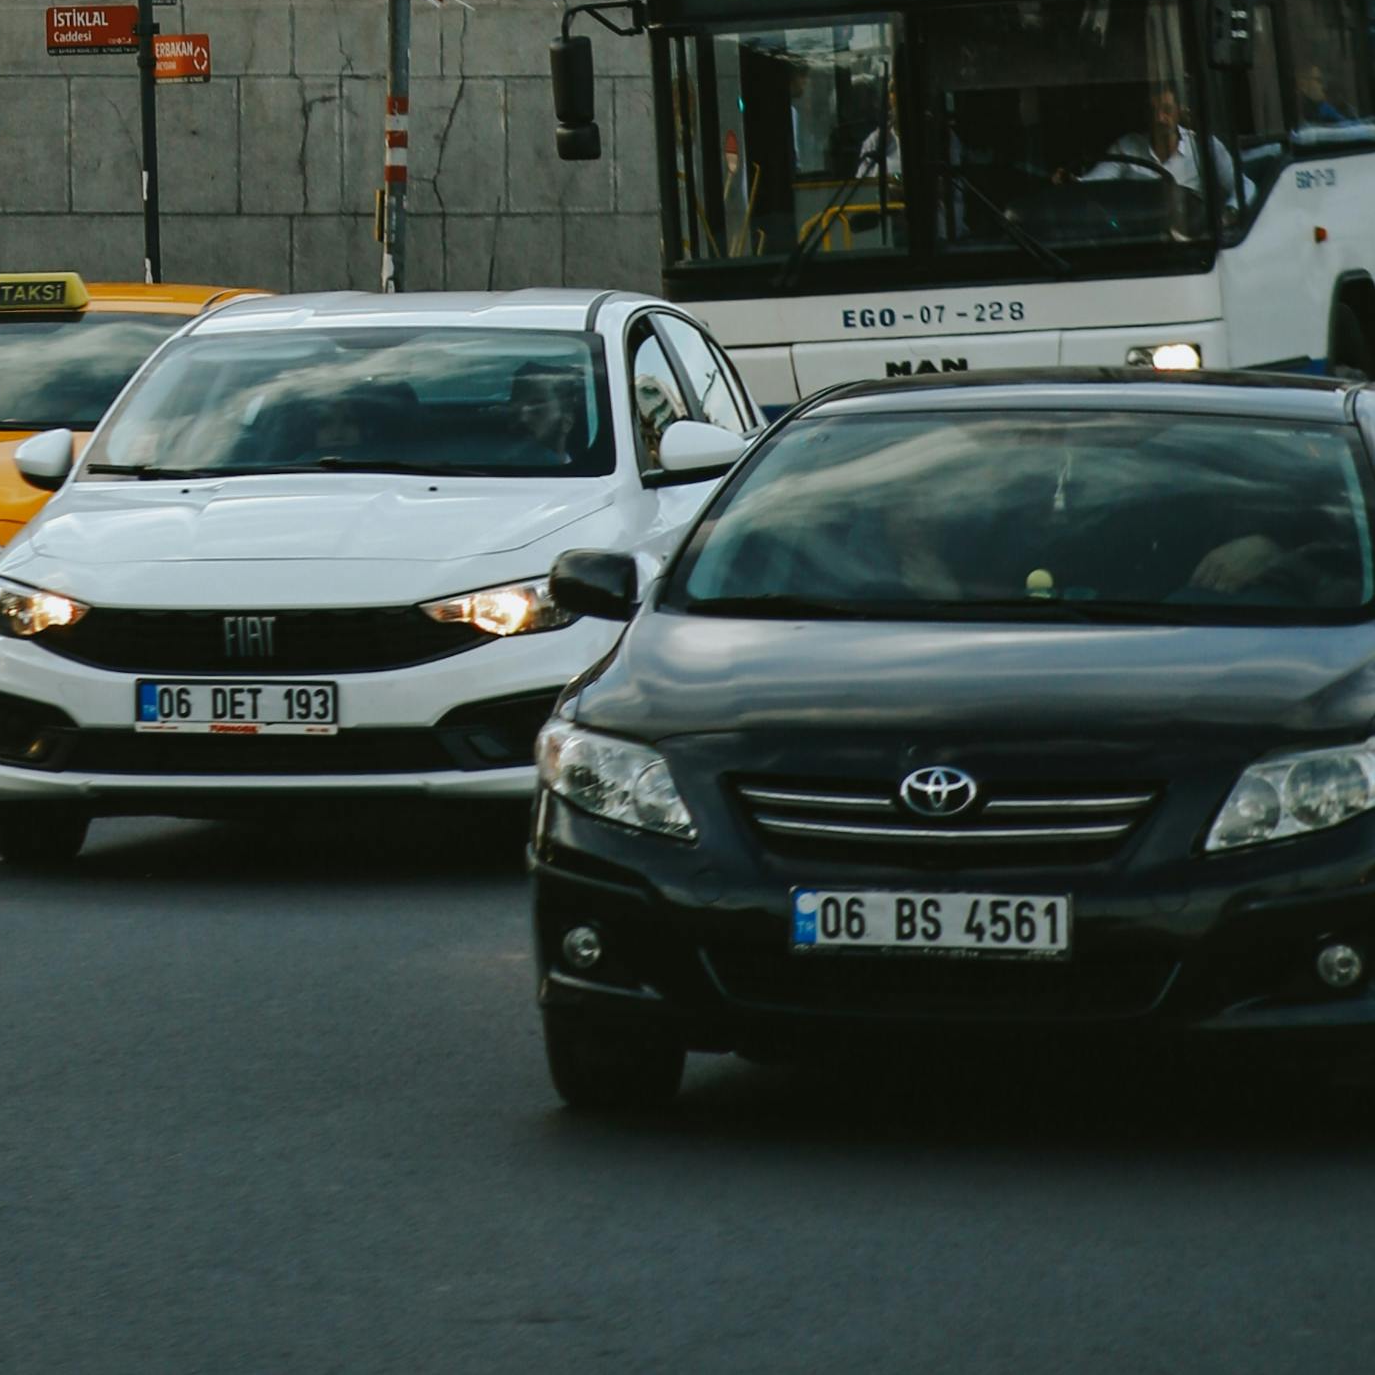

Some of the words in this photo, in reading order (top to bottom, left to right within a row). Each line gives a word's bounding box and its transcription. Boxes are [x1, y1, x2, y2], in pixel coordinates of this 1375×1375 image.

[53, 8, 109, 28] İSTİKLAL
[53, 30, 92, 43] Caddesi
[155, 41, 194, 59] ERBAKAN
[885, 358, 969, 378] MAN
[223, 616, 276, 658] FIAT
[158, 687, 192, 719] 06
[211, 687, 263, 720] DET
[283, 687, 330, 720] 193
[820, 896, 866, 940] 06
[895, 897, 942, 941] BS
[964, 899, 1059, 945] 4561
